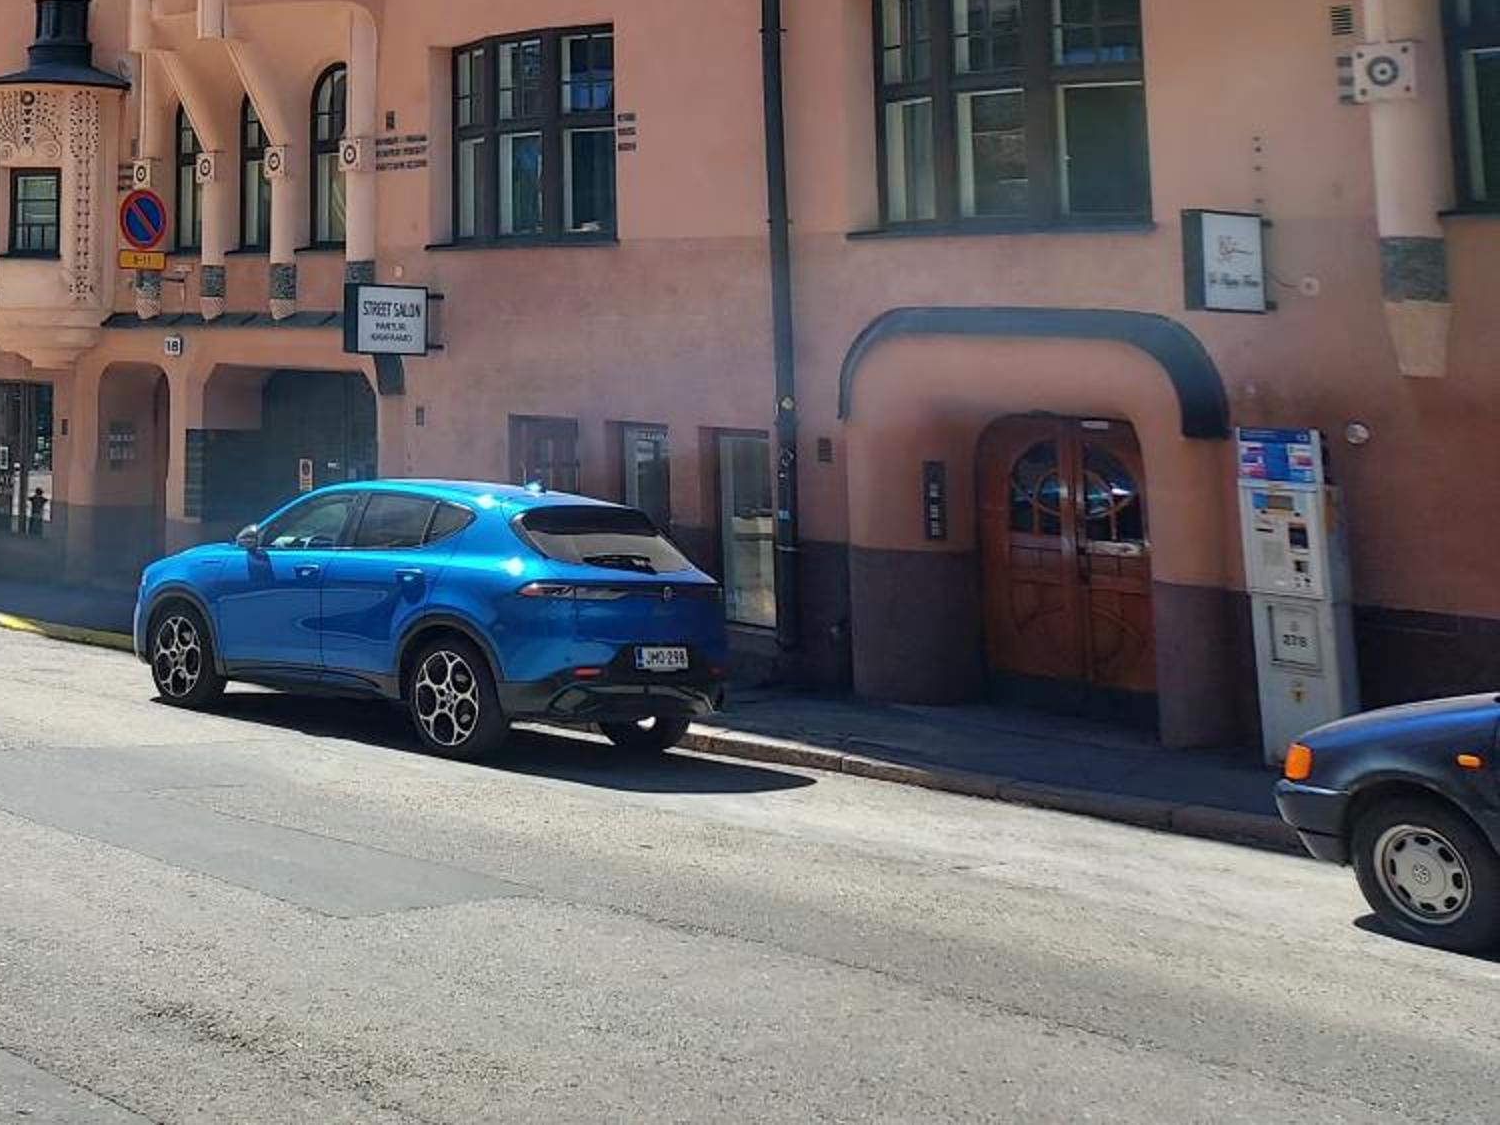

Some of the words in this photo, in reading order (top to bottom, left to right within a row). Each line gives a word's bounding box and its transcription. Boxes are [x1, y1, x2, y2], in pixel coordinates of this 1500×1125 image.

[363, 300, 392, 317] STREET
[393, 302, 421, 318] SALON
[166, 340, 179, 352] 18
